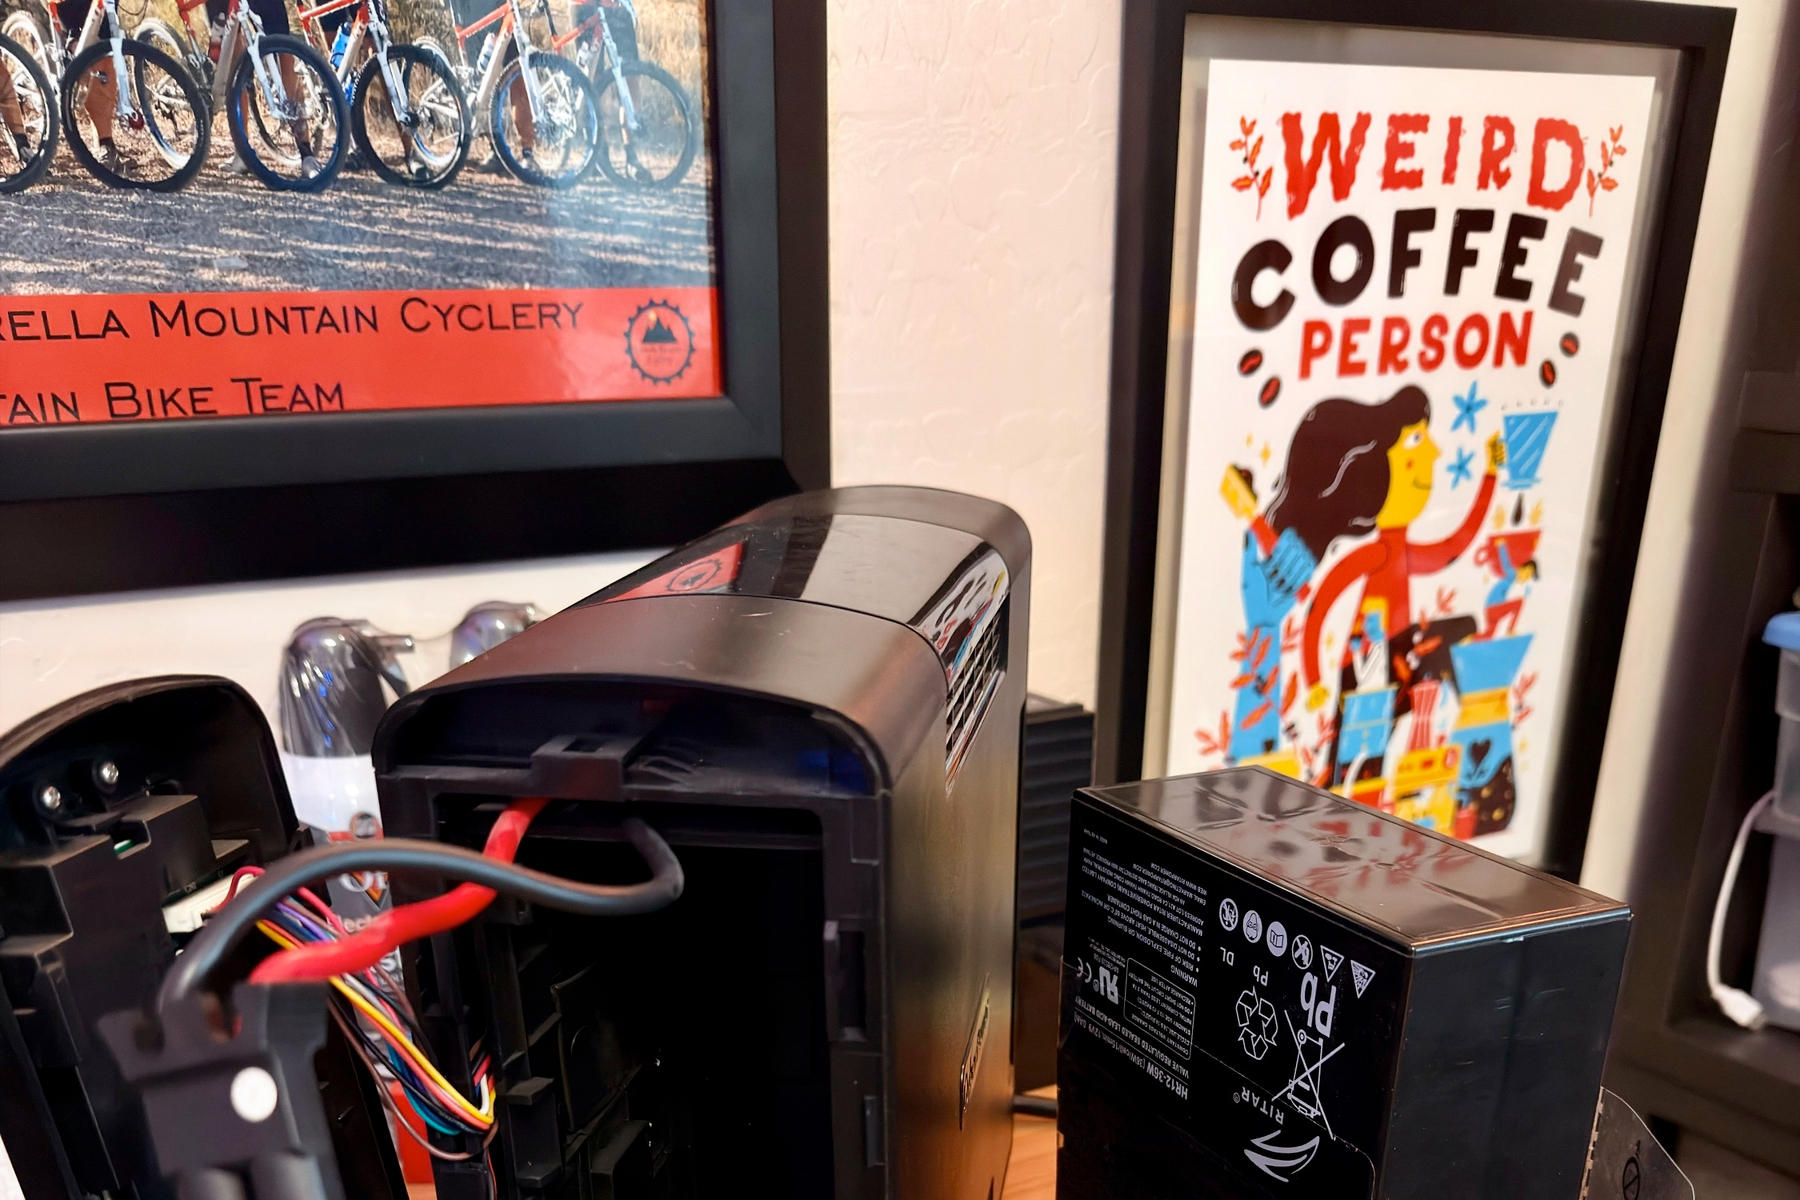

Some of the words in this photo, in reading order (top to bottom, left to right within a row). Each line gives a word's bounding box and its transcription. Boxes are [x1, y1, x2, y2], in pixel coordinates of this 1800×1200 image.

[1281, 111, 1586, 221] WEIRD
[1231, 208, 1604, 331] COFFEE
[1298, 310, 1534, 381] PERSON
[1127, 926, 1135, 937] OR
[1134, 919, 1146, 932] HEAT
[1160, 923, 1178, 940] CHARGE
[1178, 933, 1188, 945] NOT
[1188, 939, 1195, 949] DO
[1174, 953, 1181, 964] OF
[1177, 944, 1187, 955] NOT
[1187, 949, 1194, 960] DO
[1220, 947, 1234, 966] DL
[1181, 958, 1193, 971] RISK
[1170, 963, 1197, 987] WARNING
[1253, 965, 1269, 986] Pb
[1074, 993, 1095, 1015] BATTERY
[1300, 971, 1337, 1038] Pb
[1121, 1025, 1140, 1046] SEALED
[1141, 1038, 1171, 1067] REGULATED
[1171, 1059, 1189, 1079] VALVE
[1146, 1060, 1188, 1100] HR12-36W
